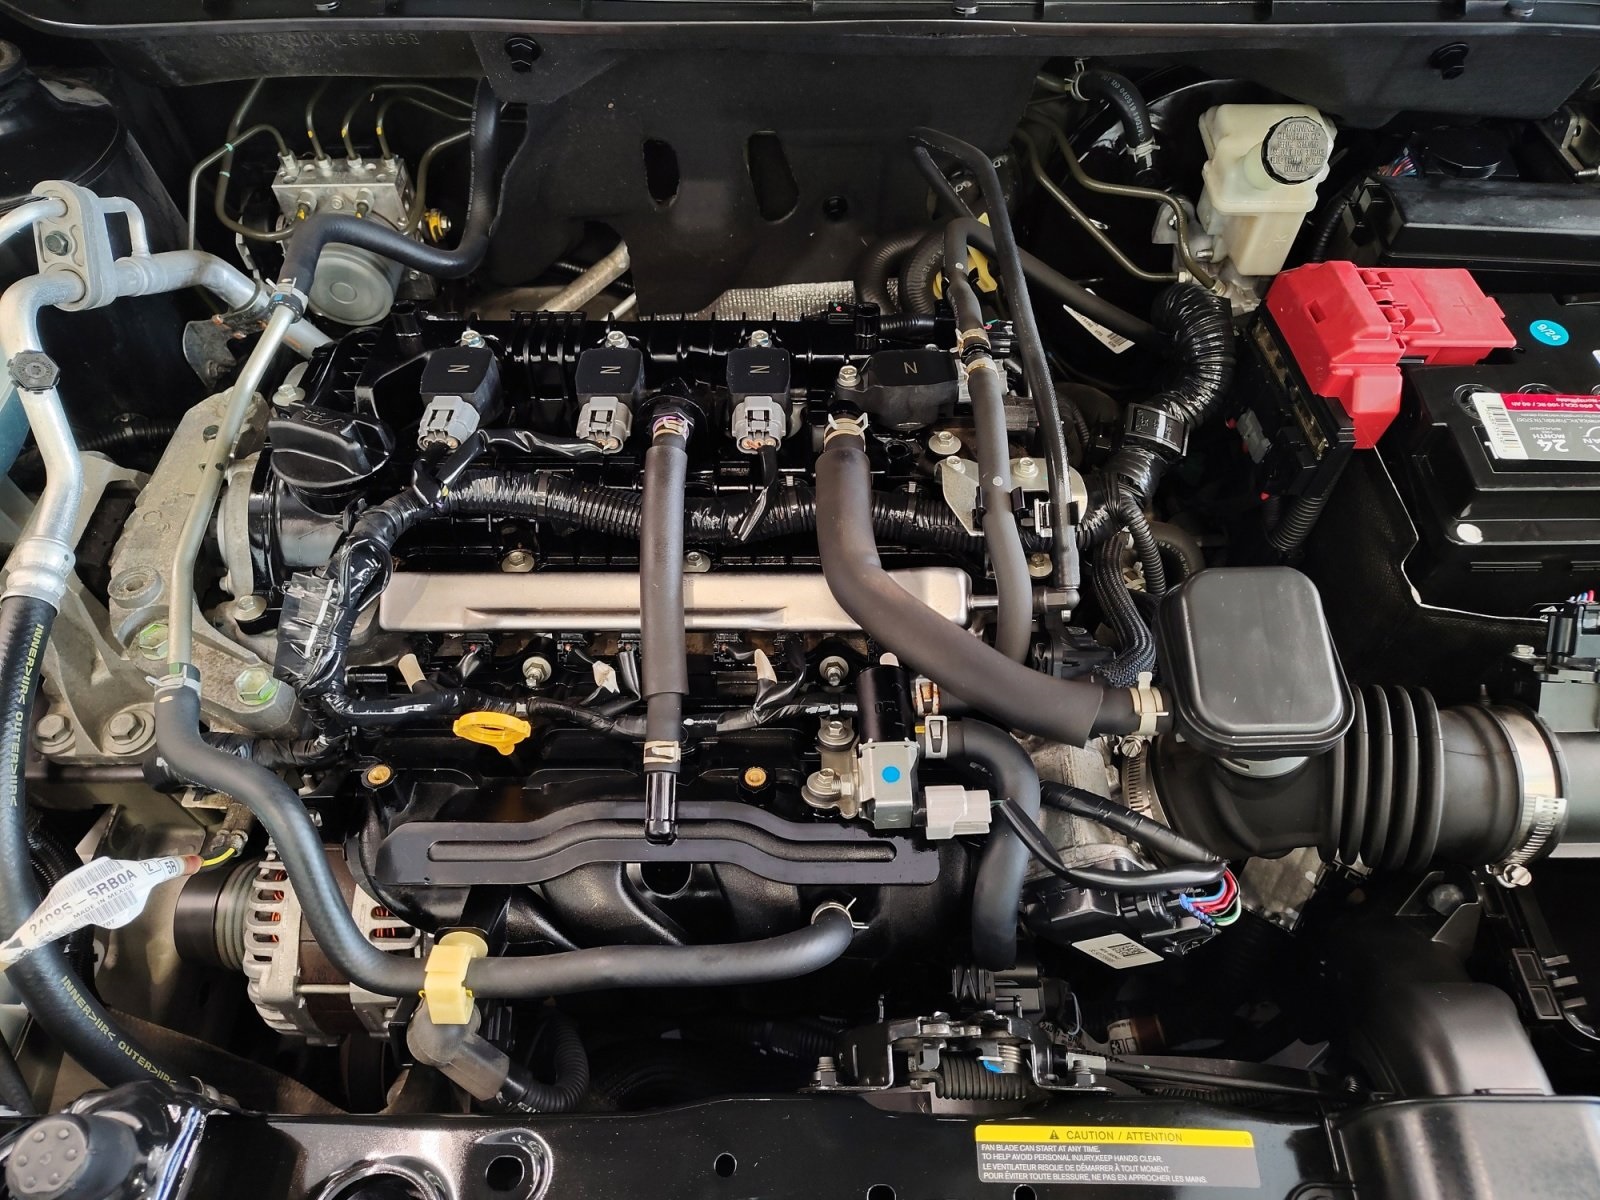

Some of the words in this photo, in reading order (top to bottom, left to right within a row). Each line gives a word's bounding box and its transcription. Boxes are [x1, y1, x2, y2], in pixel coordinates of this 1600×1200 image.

[1537, 323, 1562, 341] 9/24
[903, 361, 918, 374] N
[1536, 439, 1569, 452] 24
[72, 904, 95, 920] MADE
[97, 898, 106, 906] IN
[107, 883, 135, 899] MEXICO
[1066, 1130, 1114, 1141] CAUTION
[1126, 1131, 1183, 1142] ATTENTION
[996, 1144, 1019, 1152] BLADE
[1019, 1144, 1035, 1152] CAN
[1083, 1145, 1100, 1153] TIME.
[1011, 1153, 1032, 1161] AVOID
[1114, 1154, 1139, 1162] HANDS
[1139, 1155, 1163, 1163] CLEAR.
[992, 1163, 1037, 1171] VENTILATEUR
[1037, 1164, 1064, 1172] RISQUE
[1075, 1163, 1114, 1172] DÉMARRER
[1114, 1163, 1120, 1172] À
[1140, 1165, 1170, 1173] MOMENT.
[983, 1172, 1004, 1180] POUR
[1005, 1171, 1028, 1180] ÉVITER
[1053, 1173, 1090, 1181] BLESSURE,
[1091, 1173, 1101, 1181] NE
[1128, 1174, 1171, 1182] APPROCHER
[1185, 1176, 1208, 1184] MAINS.
